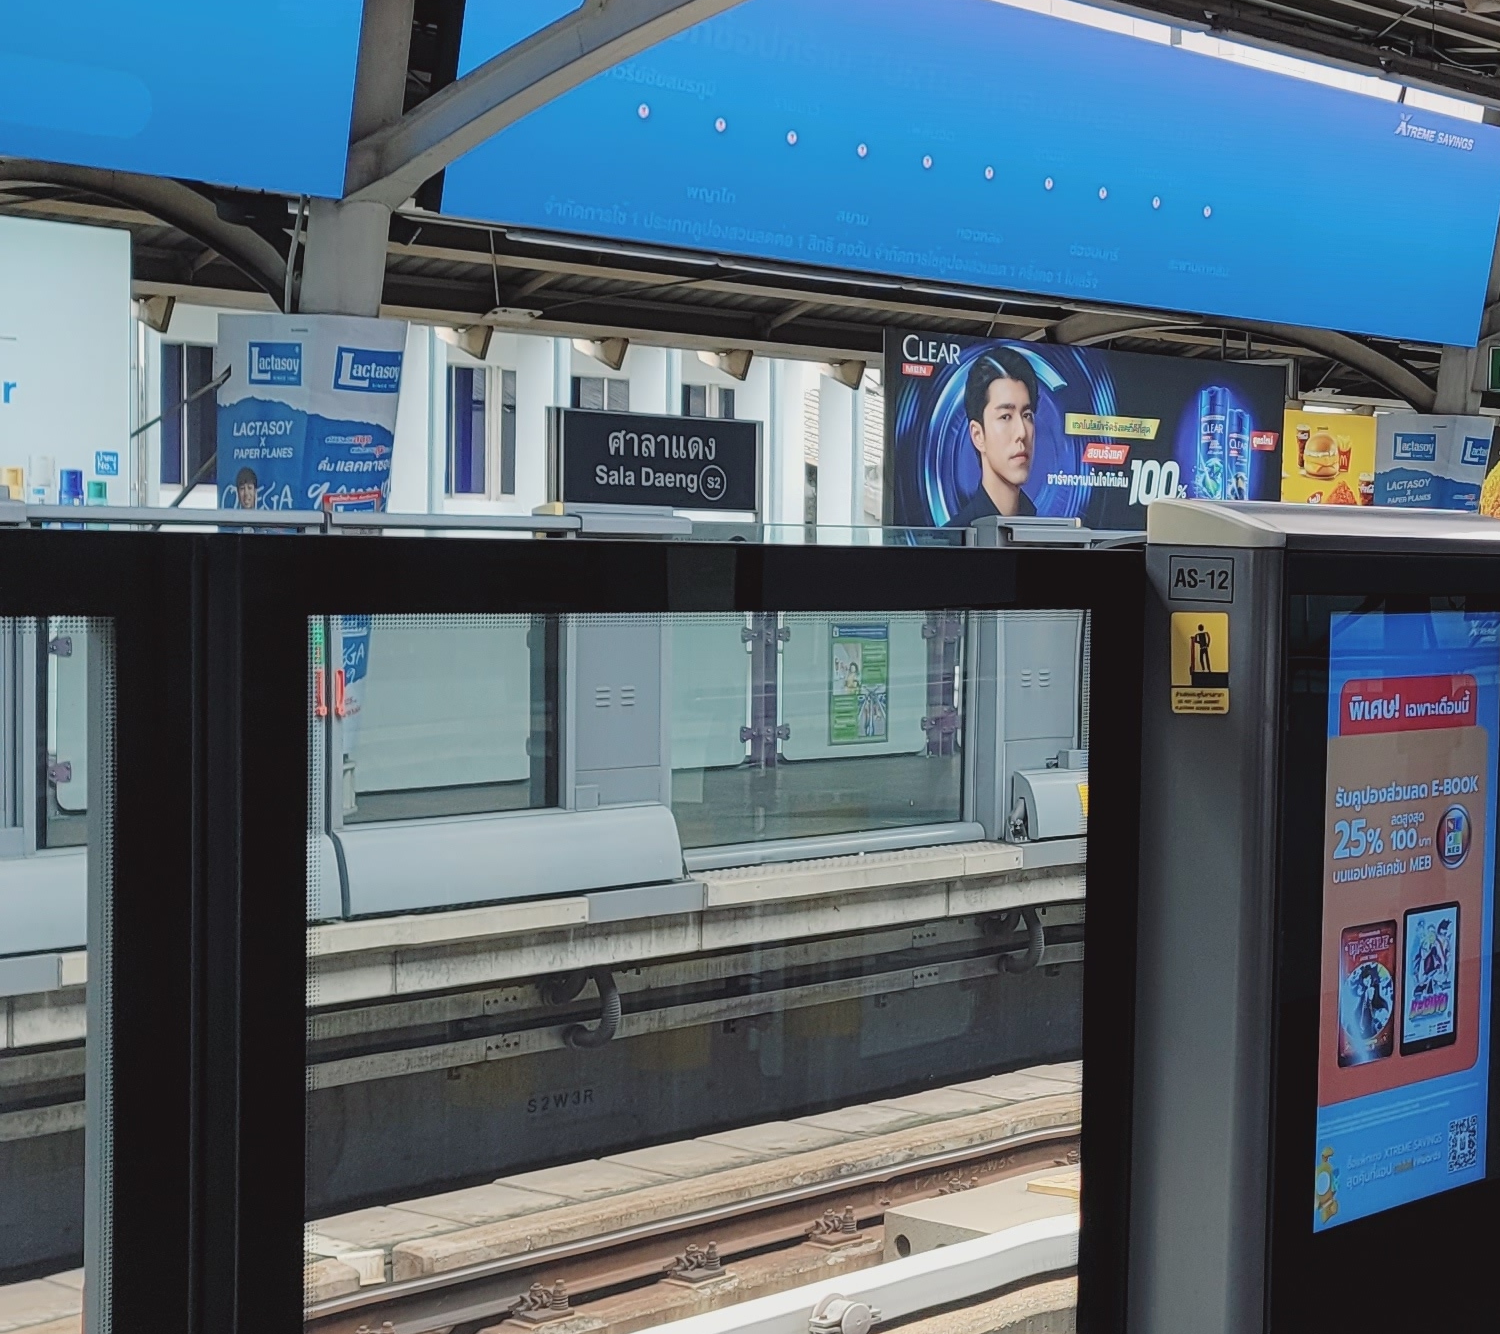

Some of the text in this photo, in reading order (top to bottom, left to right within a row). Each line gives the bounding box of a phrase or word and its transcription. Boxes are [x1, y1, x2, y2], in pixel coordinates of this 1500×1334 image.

[1394, 112, 1475, 151] XTREME SAVINGS
[251, 346, 300, 380] Lactasoy
[902, 334, 961, 366] CLEAR
[338, 351, 400, 388] Lactasoy
[232, 420, 294, 436] LACTASOY
[233, 447, 294, 460] PAPER PLANES
[608, 429, 717, 460] ศาลาแดง
[1394, 436, 1435, 458] Lactasoy
[594, 464, 721, 493] Sala Daeng S2
[1386, 477, 1432, 491] LACTASOY
[1173, 567, 1230, 590] AS-12
[1348, 689, 1472, 722] พิเศษ! เฉพาะเดือนนี้
[1334, 774, 1480, 812] รับคูปองส่วนลด E-BOOK
[1332, 818, 1384, 860] 25%
[1390, 827, 1418, 851] 100
[1409, 854, 1432, 873] MEB
[1383, 1132, 1444, 1160] XTREME SAVINGS
